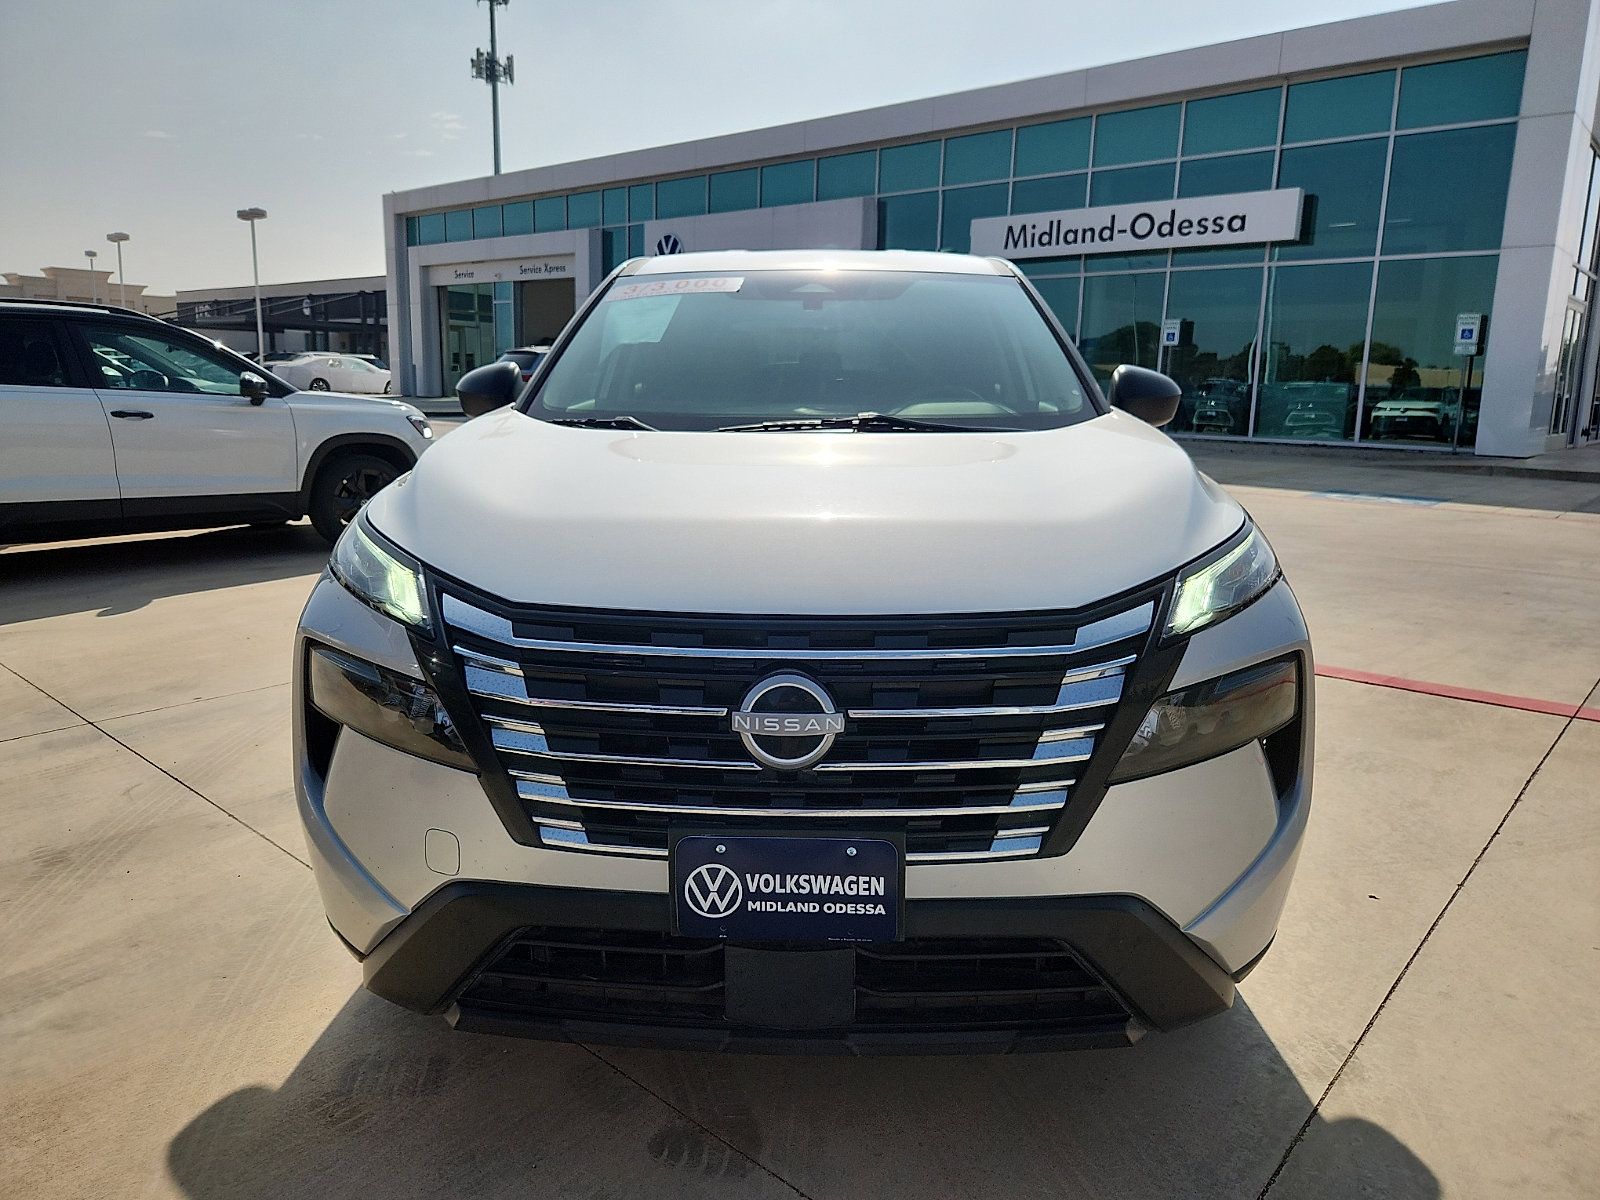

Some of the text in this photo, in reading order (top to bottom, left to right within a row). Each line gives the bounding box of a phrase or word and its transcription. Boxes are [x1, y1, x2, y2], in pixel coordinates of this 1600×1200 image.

[1003, 209, 1247, 250] Midland-Odessa
[454, 270, 475, 279] Service
[520, 262, 566, 275] Service Xpress
[734, 715, 842, 731] NISSAN
[745, 874, 885, 896] VOLKSWAGEN
[747, 901, 886, 915] MIDLAND ODESSA
